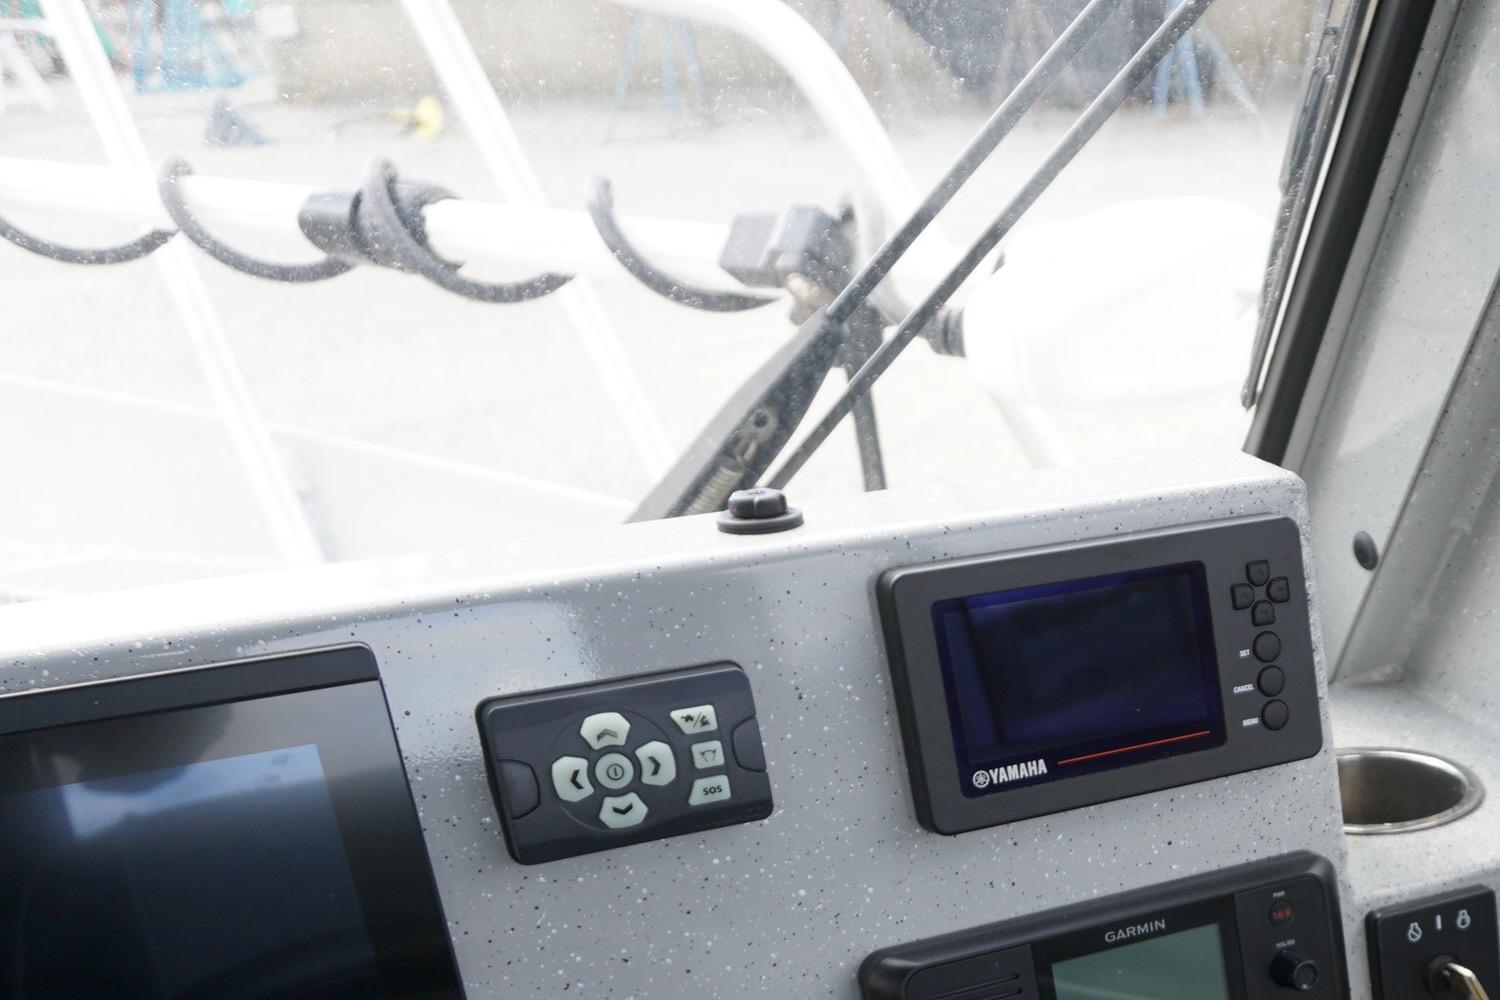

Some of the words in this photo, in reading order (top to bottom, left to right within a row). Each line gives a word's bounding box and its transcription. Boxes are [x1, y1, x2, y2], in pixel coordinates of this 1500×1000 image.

[988, 758, 1048, 785] YAMAHA
[702, 784, 723, 796] SOS
[1104, 918, 1166, 943] GARMIN
